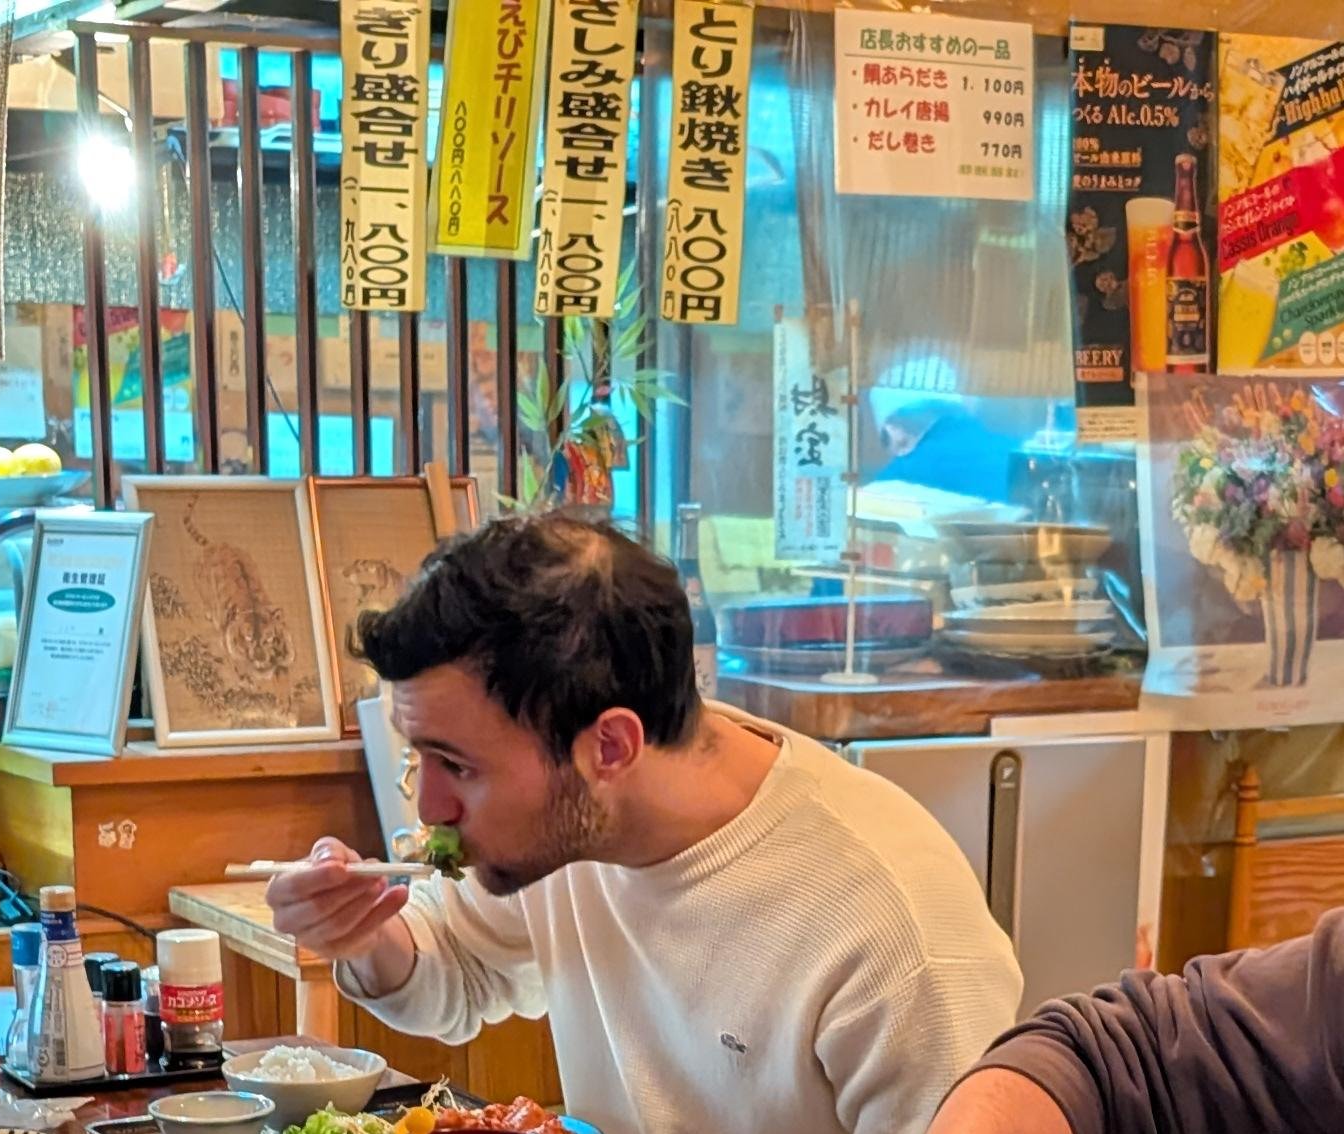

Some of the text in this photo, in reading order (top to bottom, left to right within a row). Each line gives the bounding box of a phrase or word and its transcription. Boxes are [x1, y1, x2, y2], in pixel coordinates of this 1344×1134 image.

[860, 28, 1011, 60] 店長おすすめの一品
[486, 0, 527, 225] えびチリソース
[864, 97, 1024, 127] カレイ唐揚 990円
[867, 130, 1023, 159] だし巻き 770円
